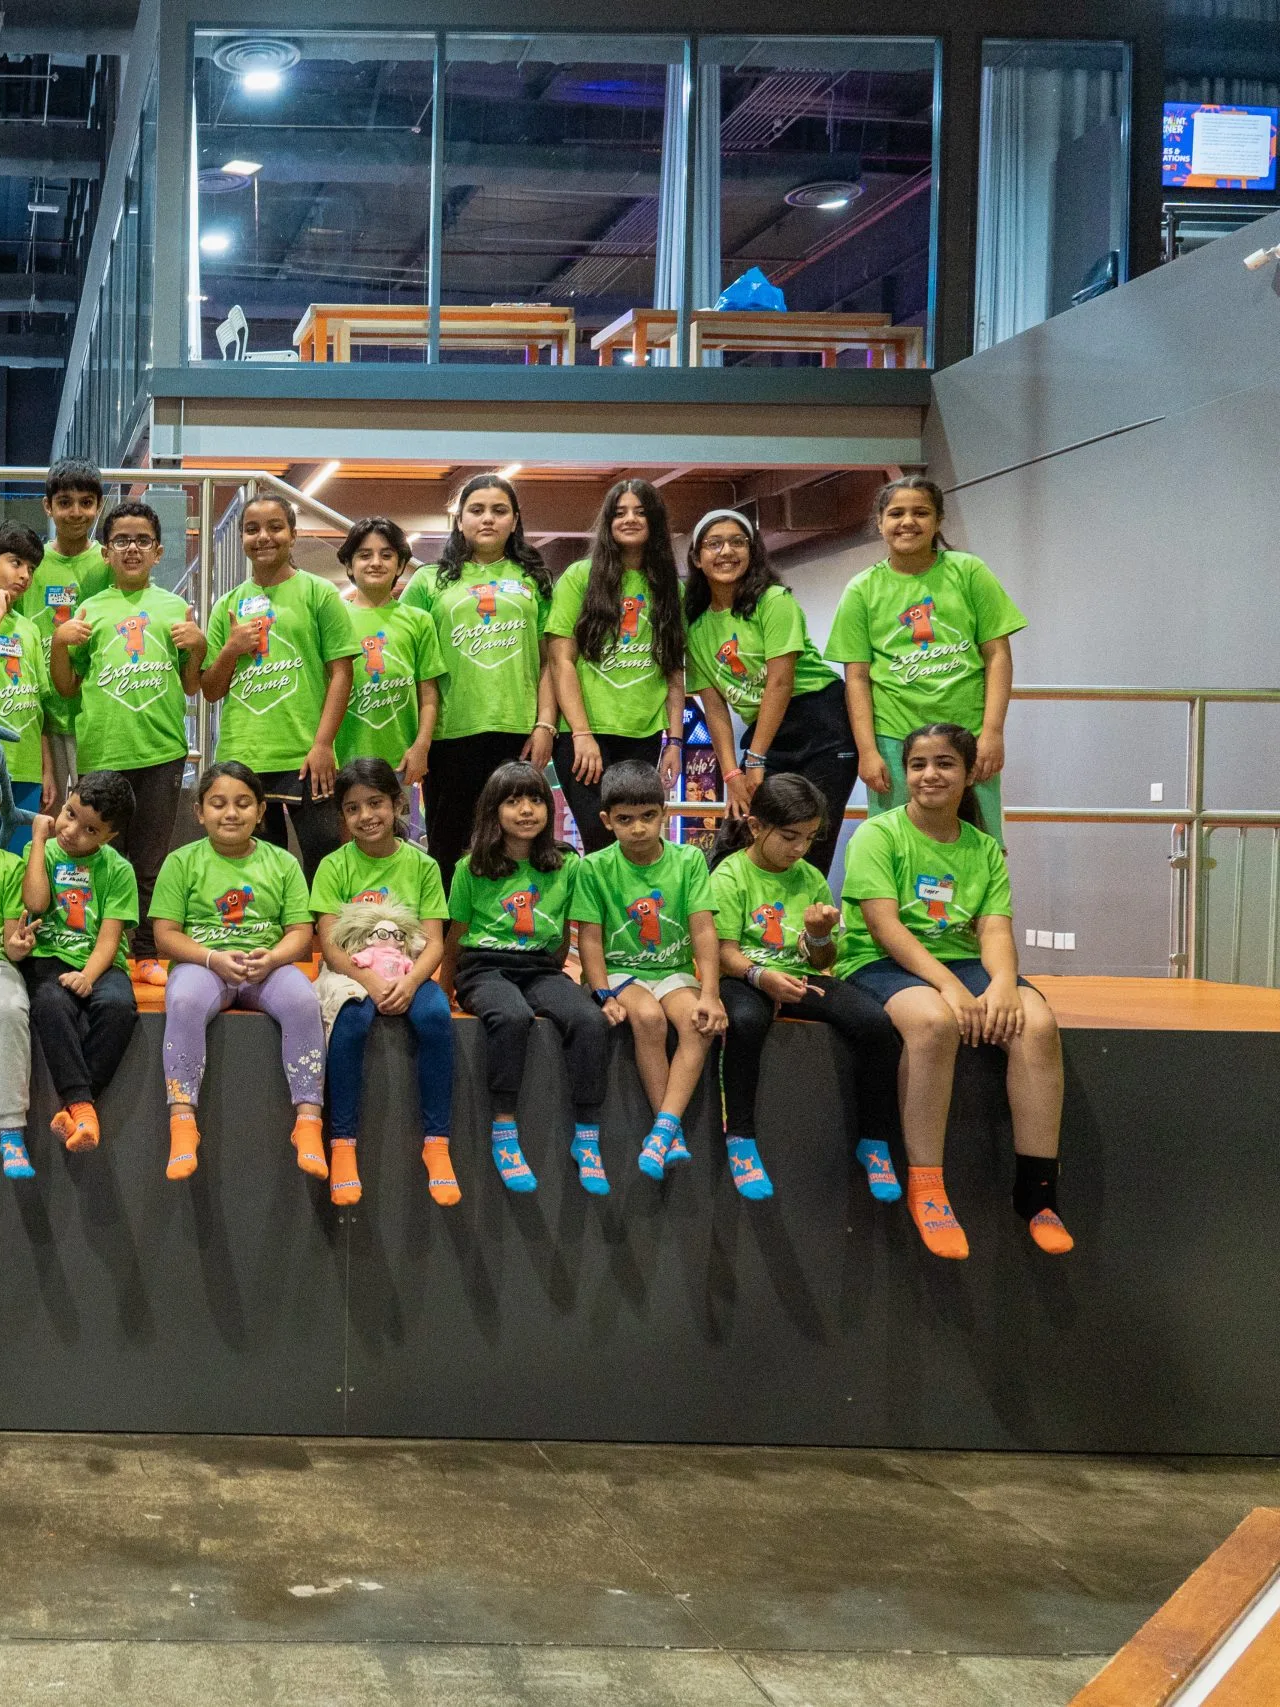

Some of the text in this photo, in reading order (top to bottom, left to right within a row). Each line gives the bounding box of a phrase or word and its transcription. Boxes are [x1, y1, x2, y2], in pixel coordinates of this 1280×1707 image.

[450, 619, 527, 647] Extreme
[469, 635, 517, 656] Camp
[600, 656, 652, 672] Camp
[888, 640, 972, 671] Extreme
[97, 660, 173, 688] Extreme
[905, 659, 962, 684] Camp
[114, 675, 164, 696] Camp
[241, 674, 290, 700] Camp
[192, 921, 272, 943] Extrem
